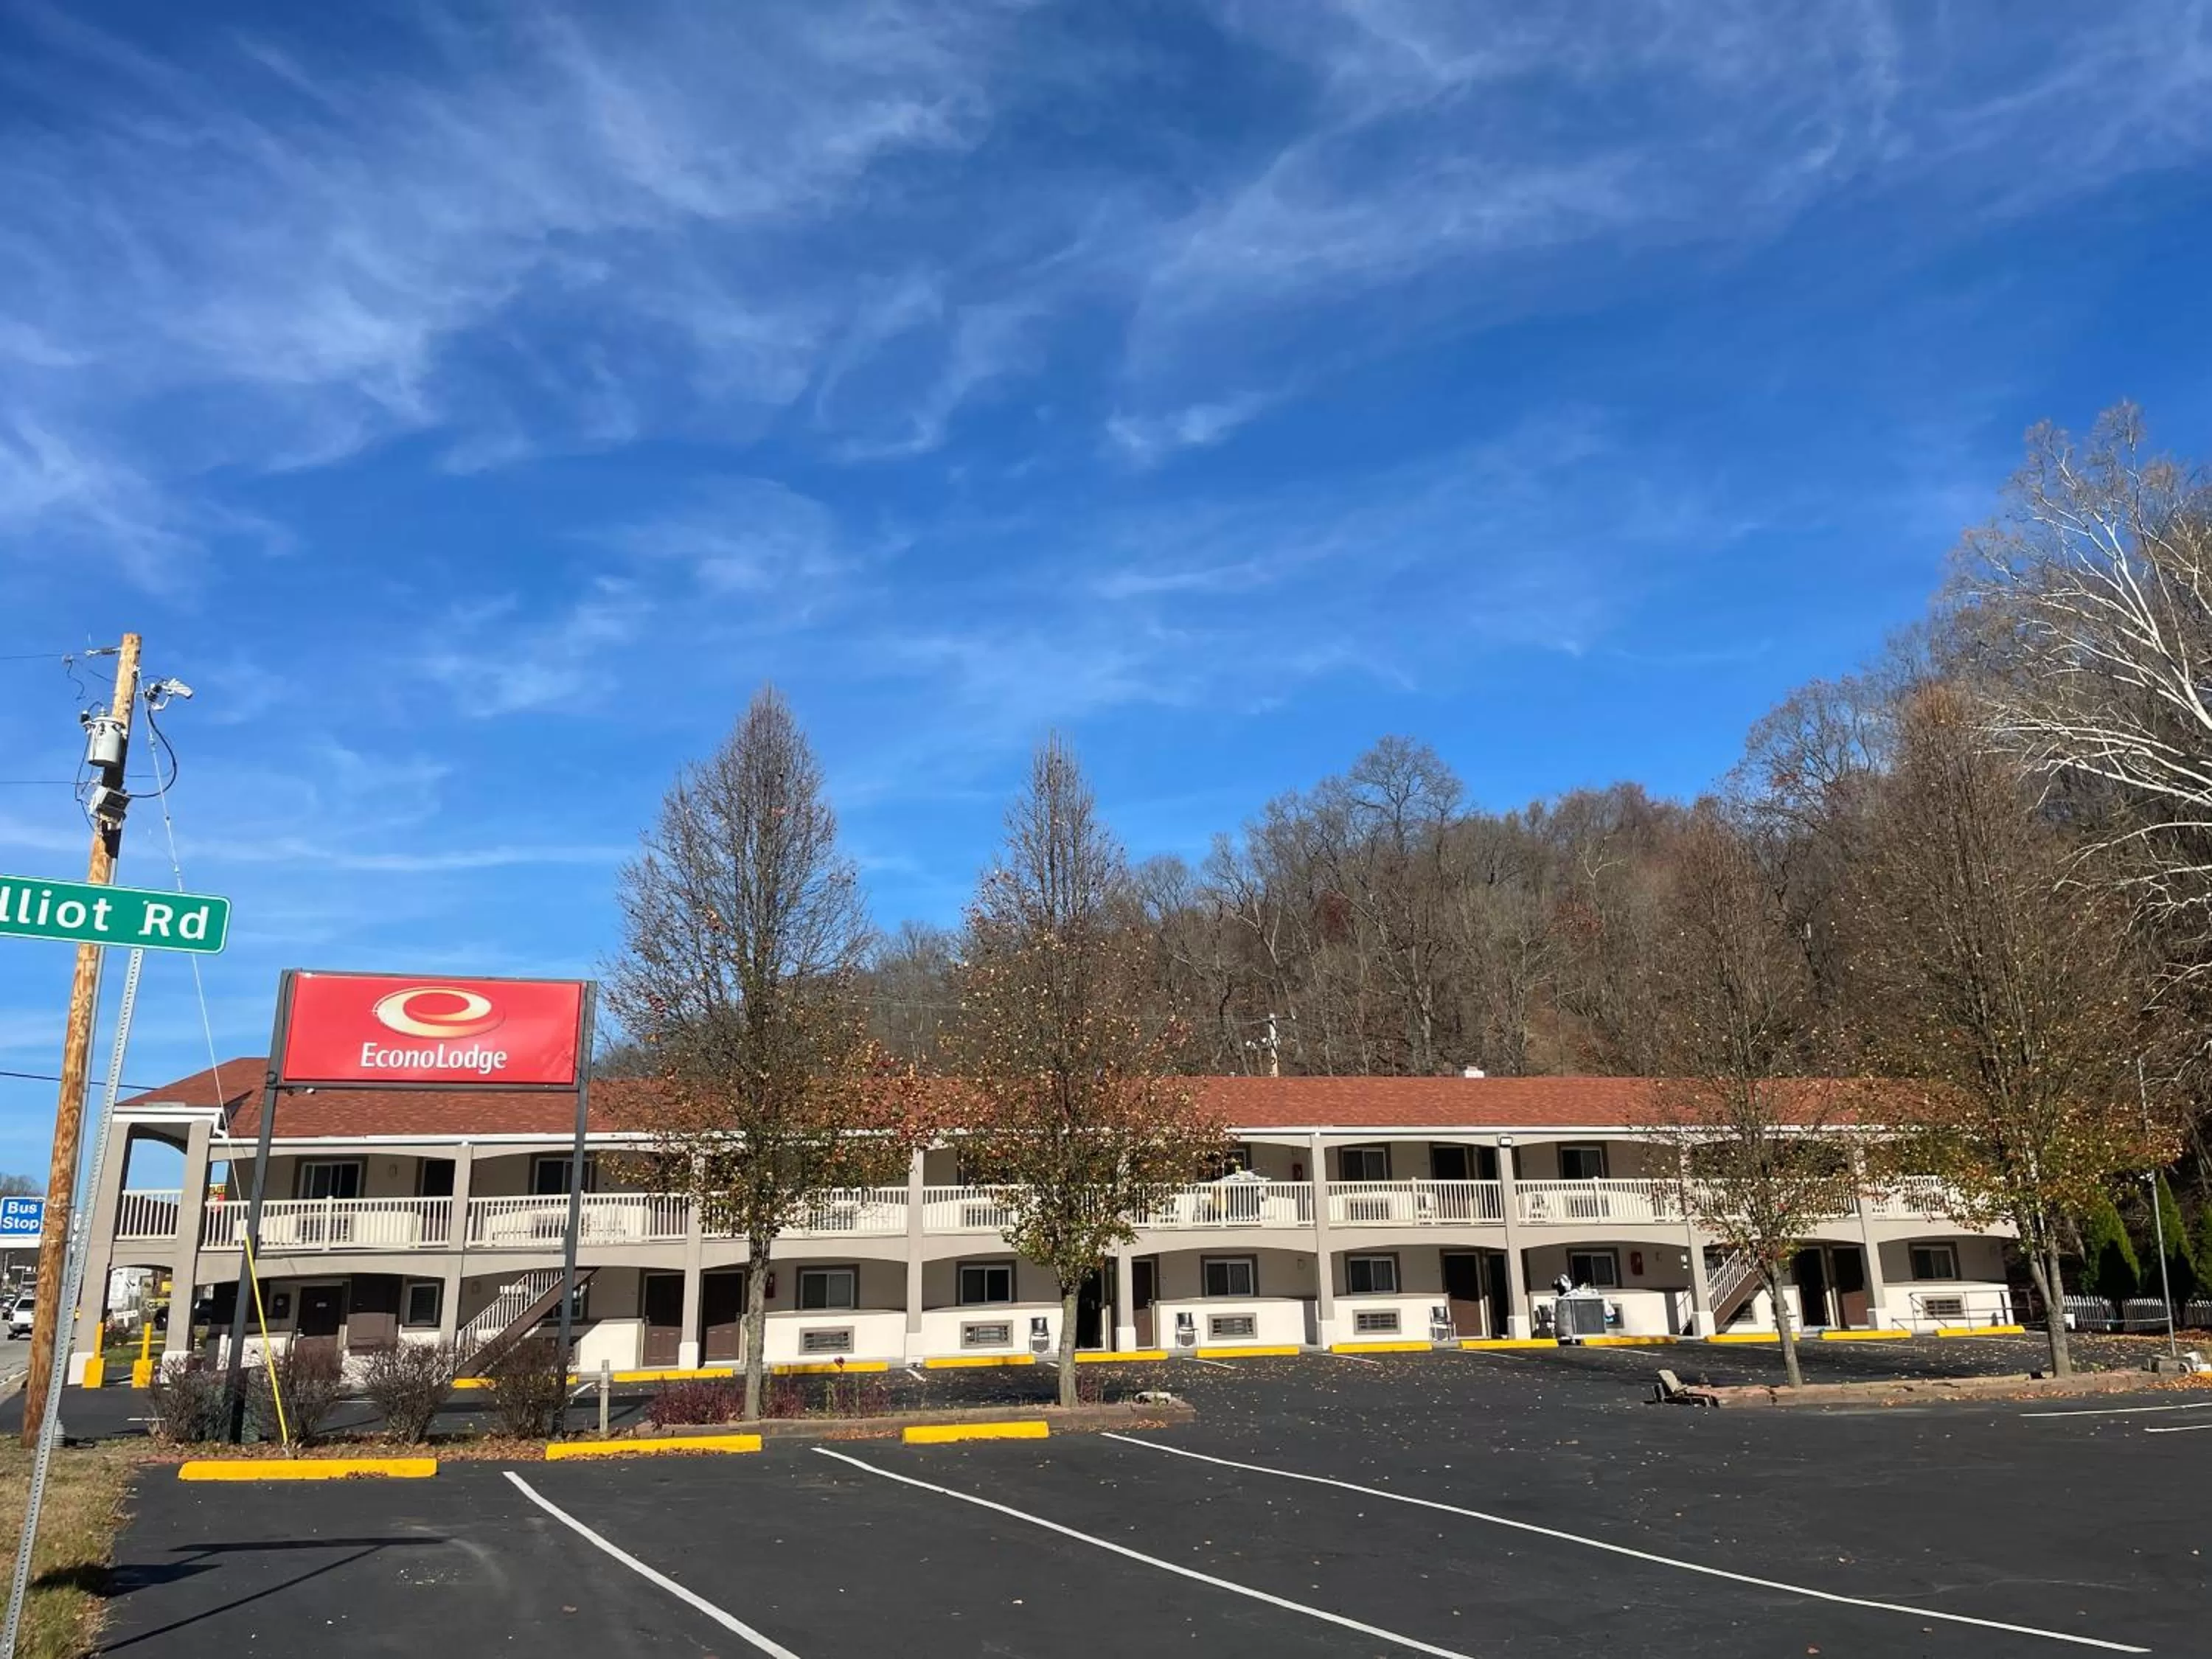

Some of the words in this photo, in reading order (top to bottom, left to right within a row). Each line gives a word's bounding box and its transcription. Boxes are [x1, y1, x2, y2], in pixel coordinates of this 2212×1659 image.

[138, 900, 210, 940] Rd
[360, 1041, 508, 1074] EconoLodge
[7, 1201, 38, 1214] Bus
[2, 1216, 39, 1231] Stop
